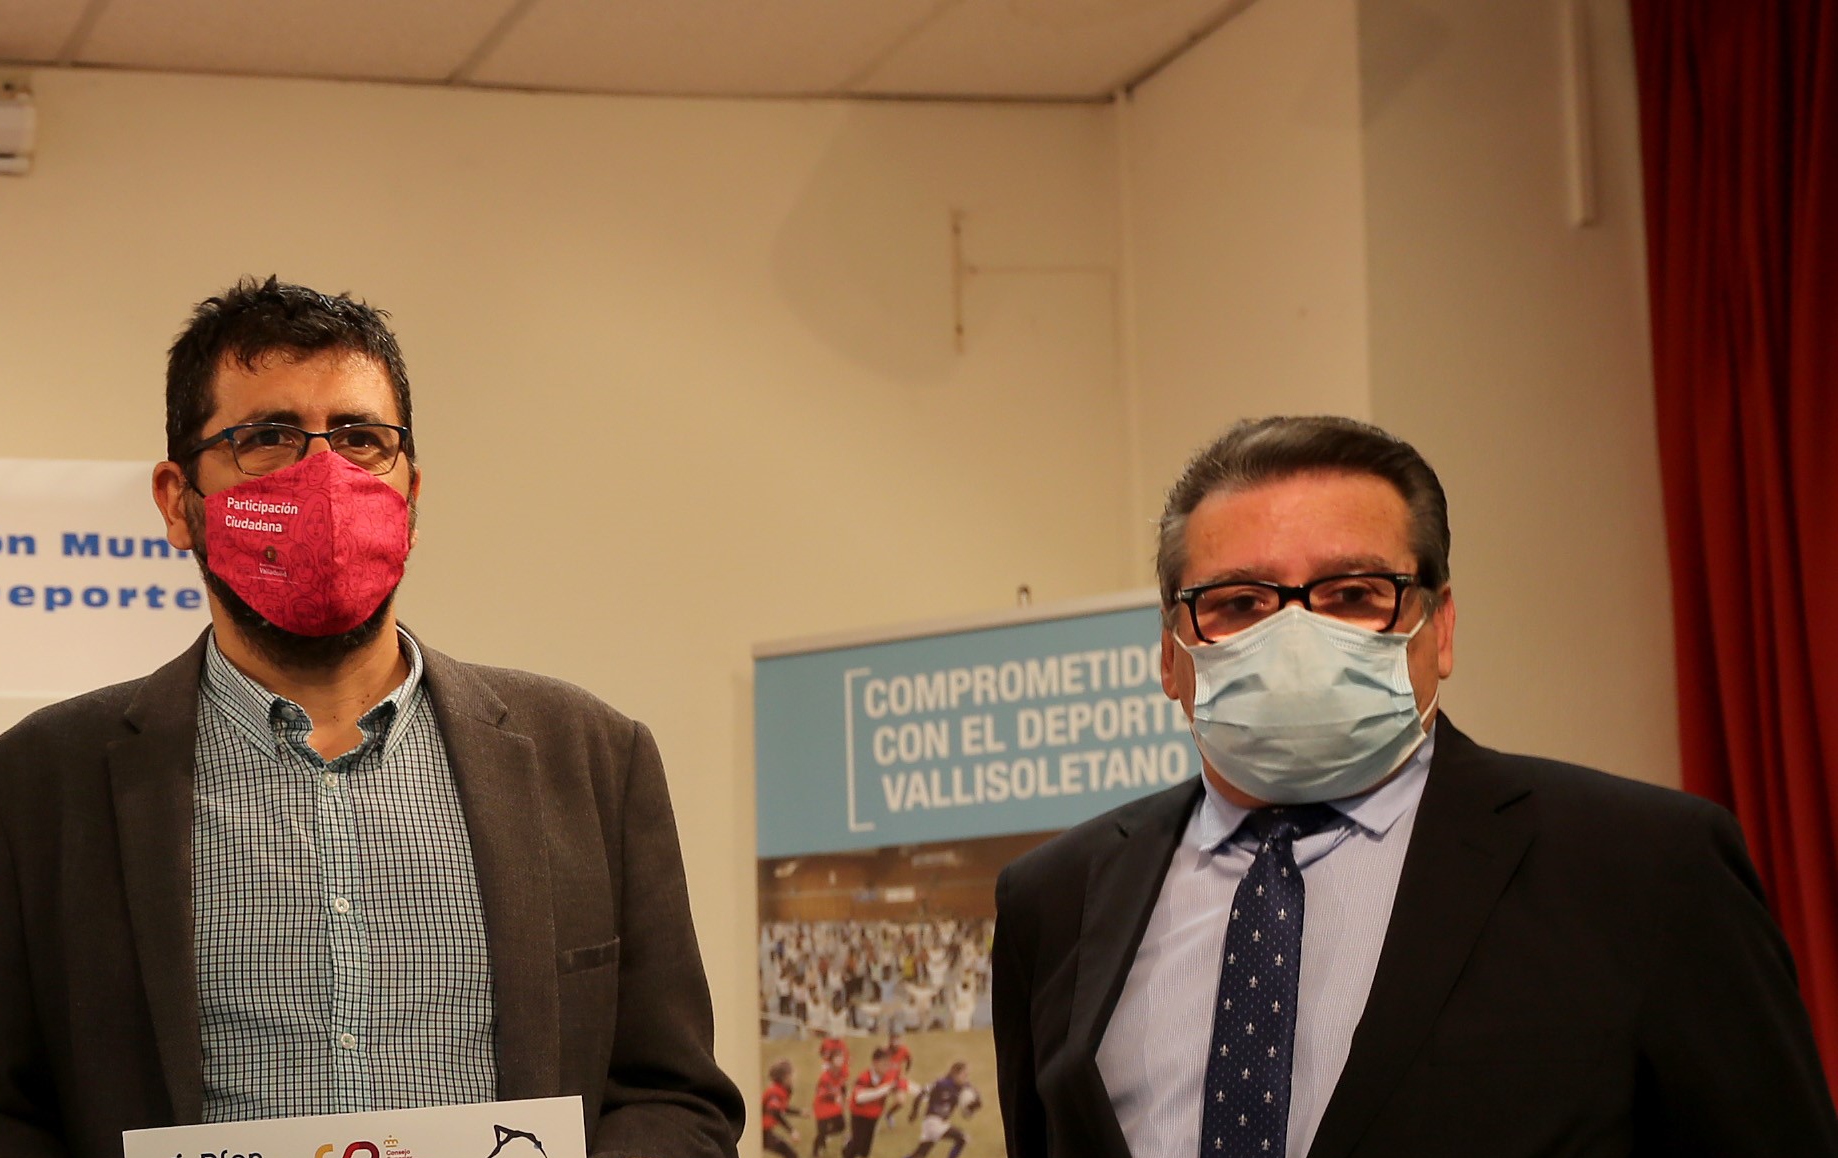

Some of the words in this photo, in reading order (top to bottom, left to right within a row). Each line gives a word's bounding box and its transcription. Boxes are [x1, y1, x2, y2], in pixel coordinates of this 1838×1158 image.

[227, 497, 298, 515] Participación
[225, 515, 283, 533] Ciudadana
[63, 532, 188, 558] Mun
[872, 720, 949, 767] CON
[961, 713, 1006, 757] EL
[882, 742, 1189, 813] VALLISOLETANO
[386, 1148, 411, 1157] Consejo
